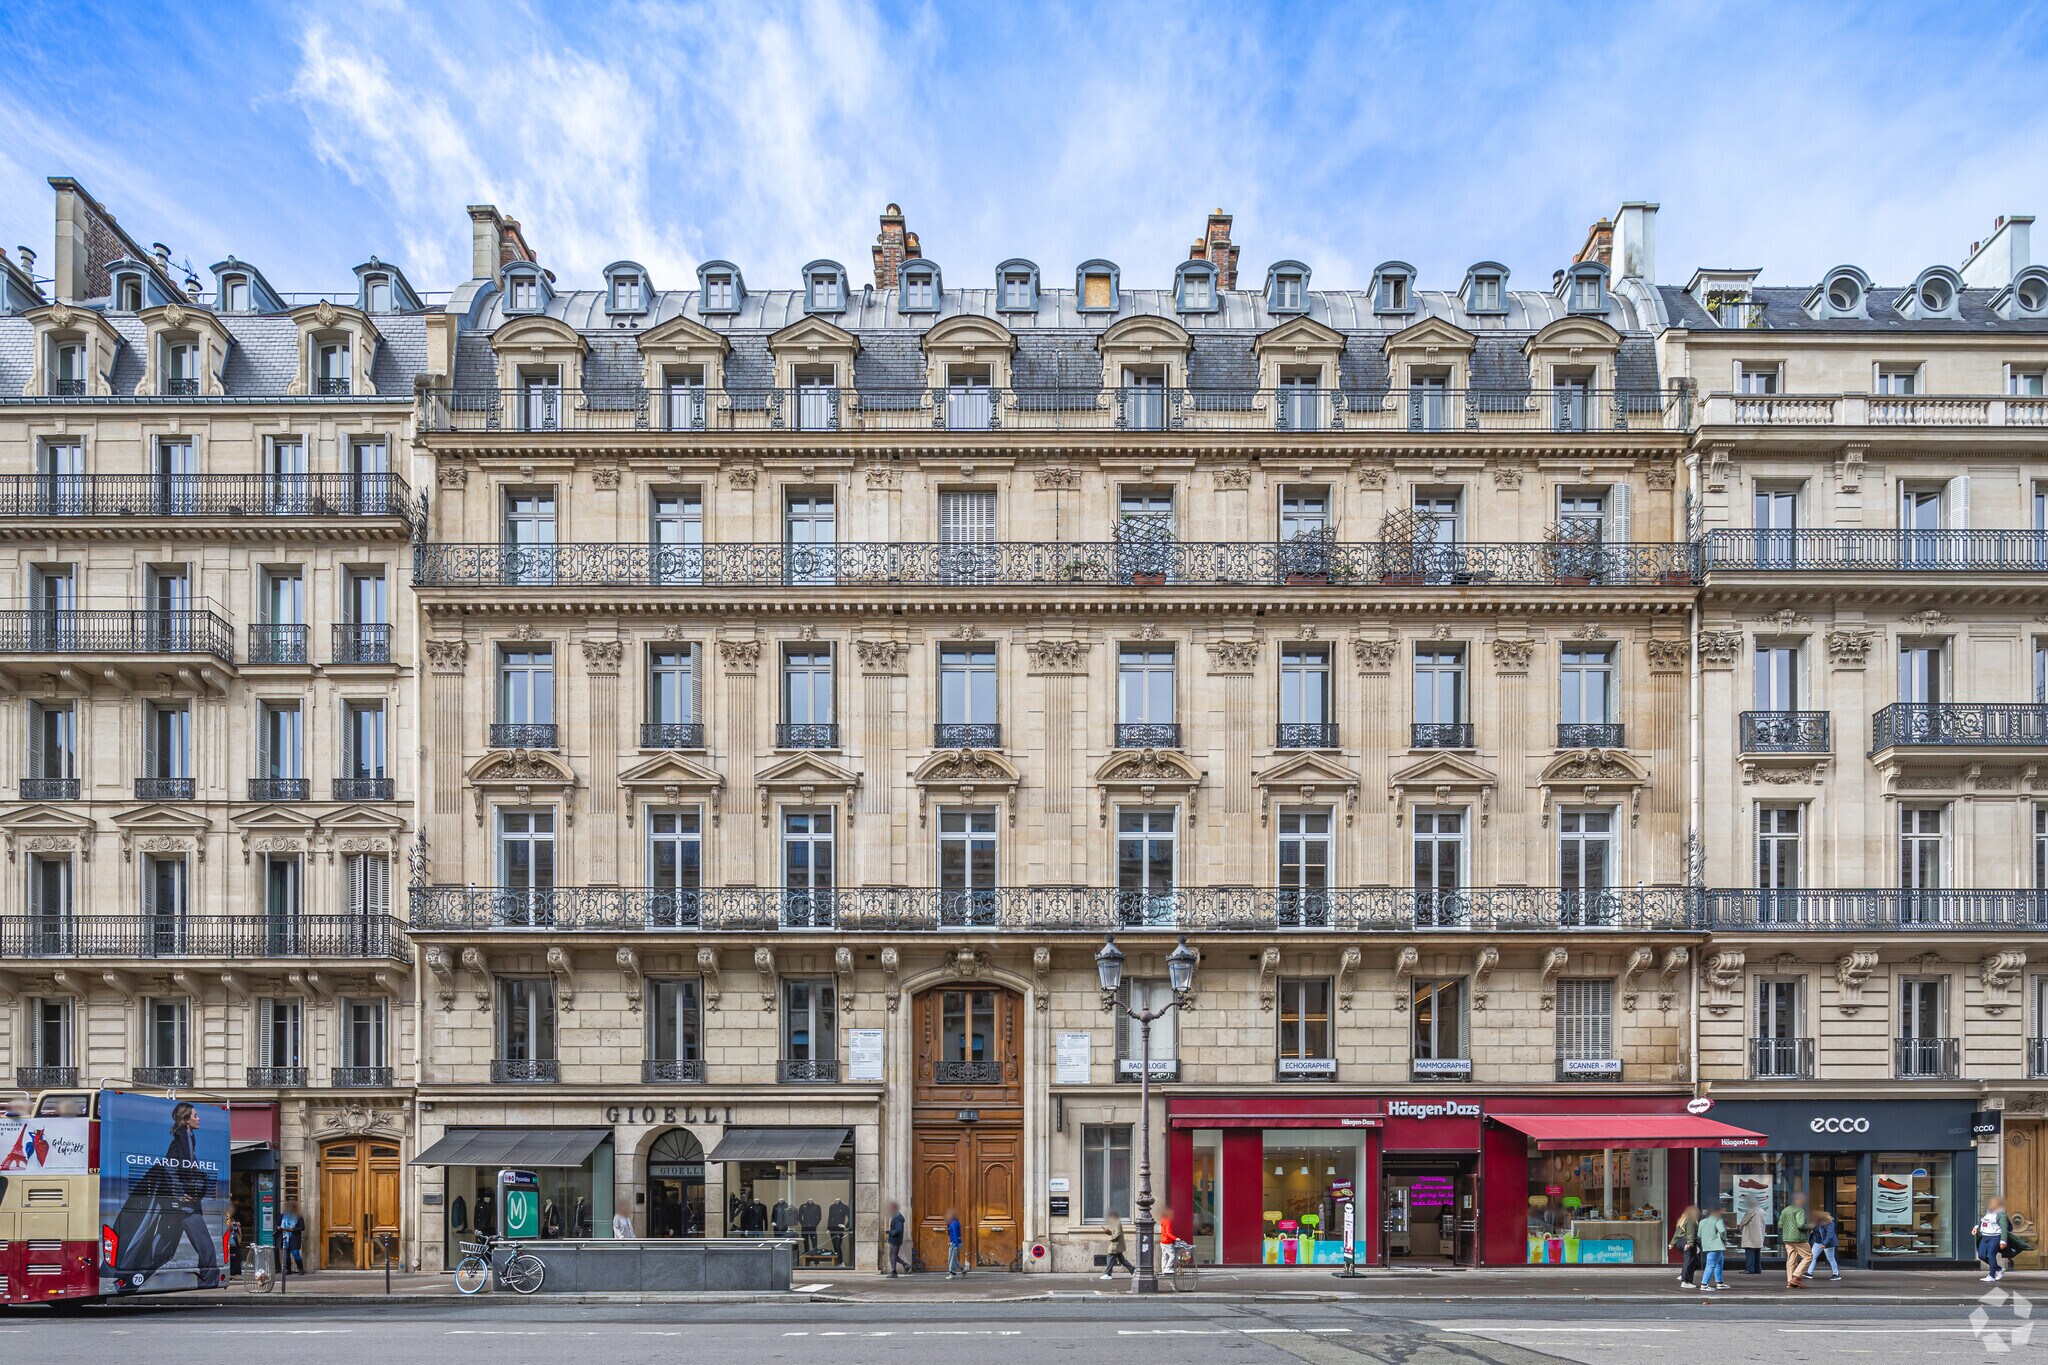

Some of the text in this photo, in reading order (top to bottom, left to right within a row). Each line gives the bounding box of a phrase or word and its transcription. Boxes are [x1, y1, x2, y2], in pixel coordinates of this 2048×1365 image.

[606, 1106, 732, 1123] GIOELLI
[1810, 1118, 1870, 1133] ecco
[126, 1154, 218, 1170] GERARD DAREL
[510, 1198, 522, 1220] M
